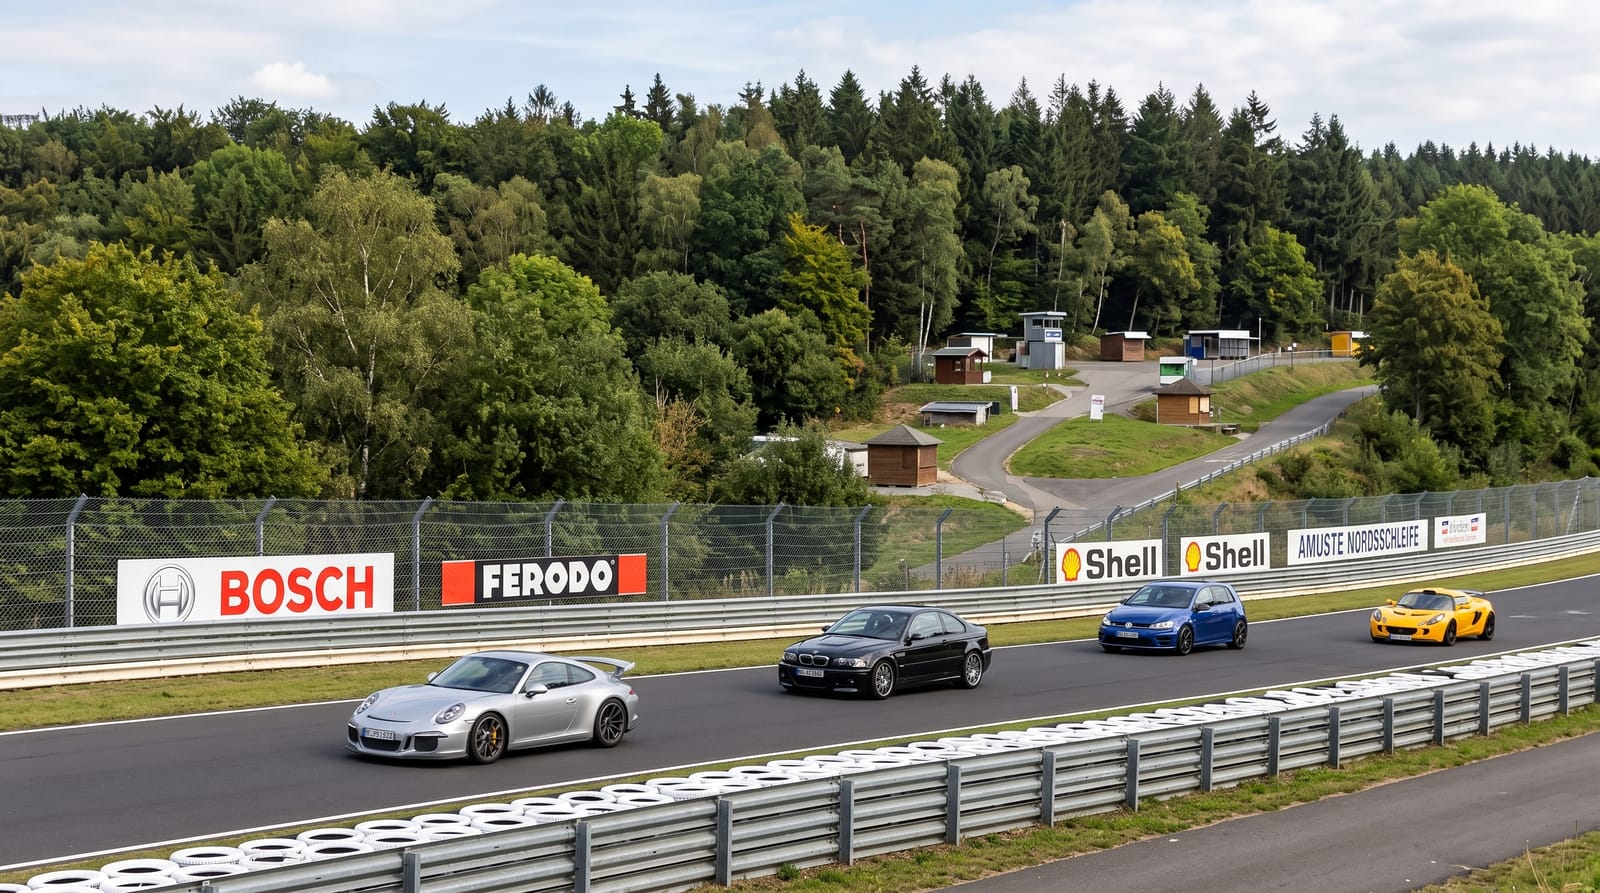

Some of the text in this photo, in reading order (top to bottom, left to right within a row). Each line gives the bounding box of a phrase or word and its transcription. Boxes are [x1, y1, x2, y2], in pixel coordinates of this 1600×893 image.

[1206, 539, 1265, 571] Shell
[1298, 532, 1344, 559] AMUSTE
[1347, 525, 1419, 554] NORDSSCHLEIFE
[483, 559, 613, 598] FERODO
[1086, 546, 1157, 580] Shell
[220, 565, 374, 616] BOSCH
